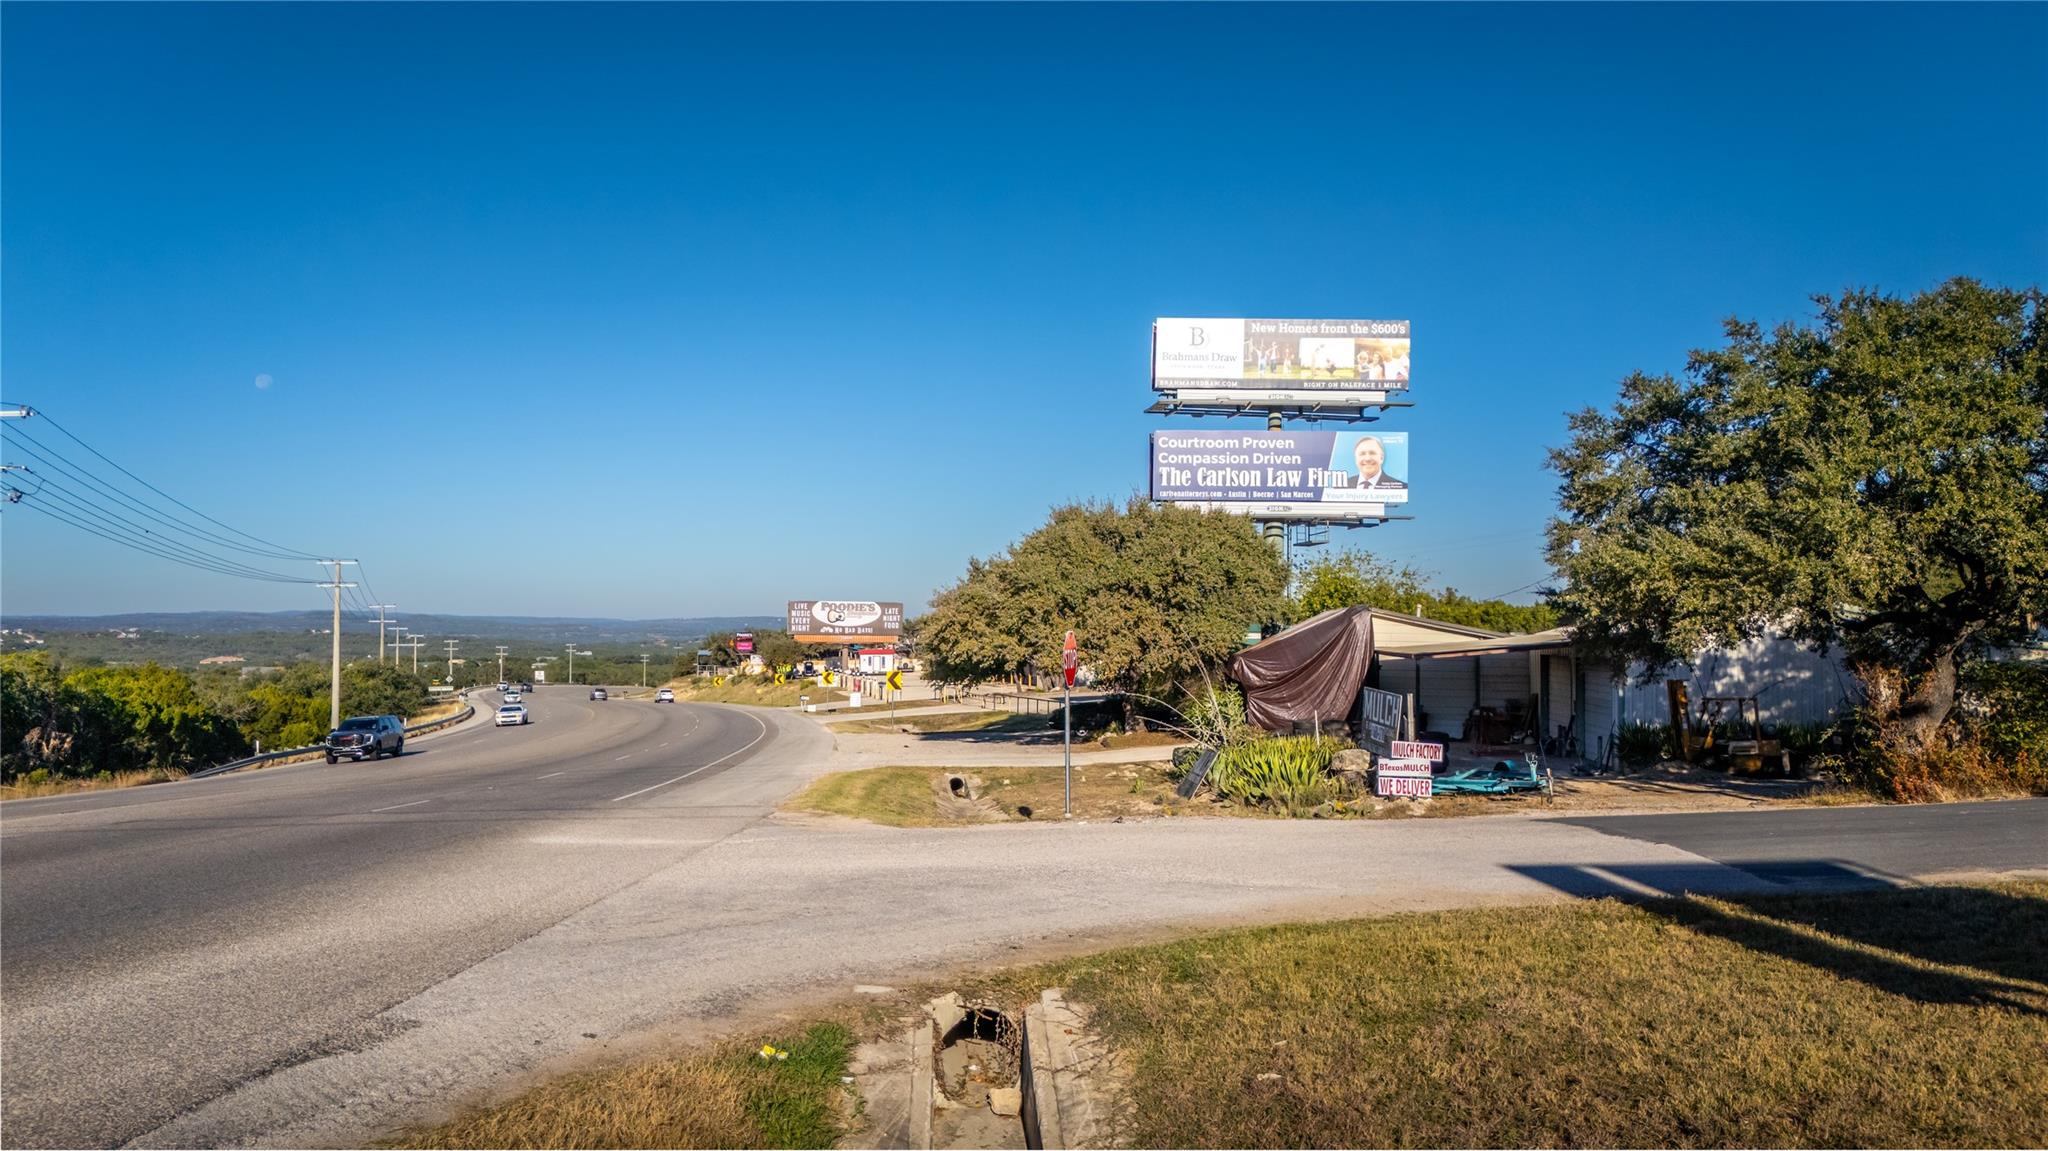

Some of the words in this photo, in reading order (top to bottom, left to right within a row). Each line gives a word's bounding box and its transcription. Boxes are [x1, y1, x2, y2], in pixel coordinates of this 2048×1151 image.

[1251, 322, 1277, 333] New
[1280, 322, 1318, 334] Homes
[1320, 322, 1347, 334] from
[1350, 323, 1369, 334] the
[1370, 323, 1406, 334] $600's
[1162, 352, 1210, 361] Brahmans
[1211, 352, 1238, 362] Draw
[1158, 436, 1239, 448] Courtroom
[1242, 437, 1294, 448] Proven
[1158, 452, 1249, 466] Compassion
[1253, 452, 1301, 464] Driven
[1159, 466, 1192, 486] The
[1197, 467, 1260, 487] Carlson
[1267, 468, 1302, 487] Law
[1307, 468, 1348, 488] Firm
[820, 602, 876, 612] POODIE'S
[1064, 649, 1077, 670] STOP
[1364, 688, 1400, 727] MULCH
[1392, 742, 1414, 758] MULCH
[1416, 743, 1442, 760] FACTORY
[1380, 778, 1393, 794] WE
[1396, 779, 1431, 796] DELIVER
